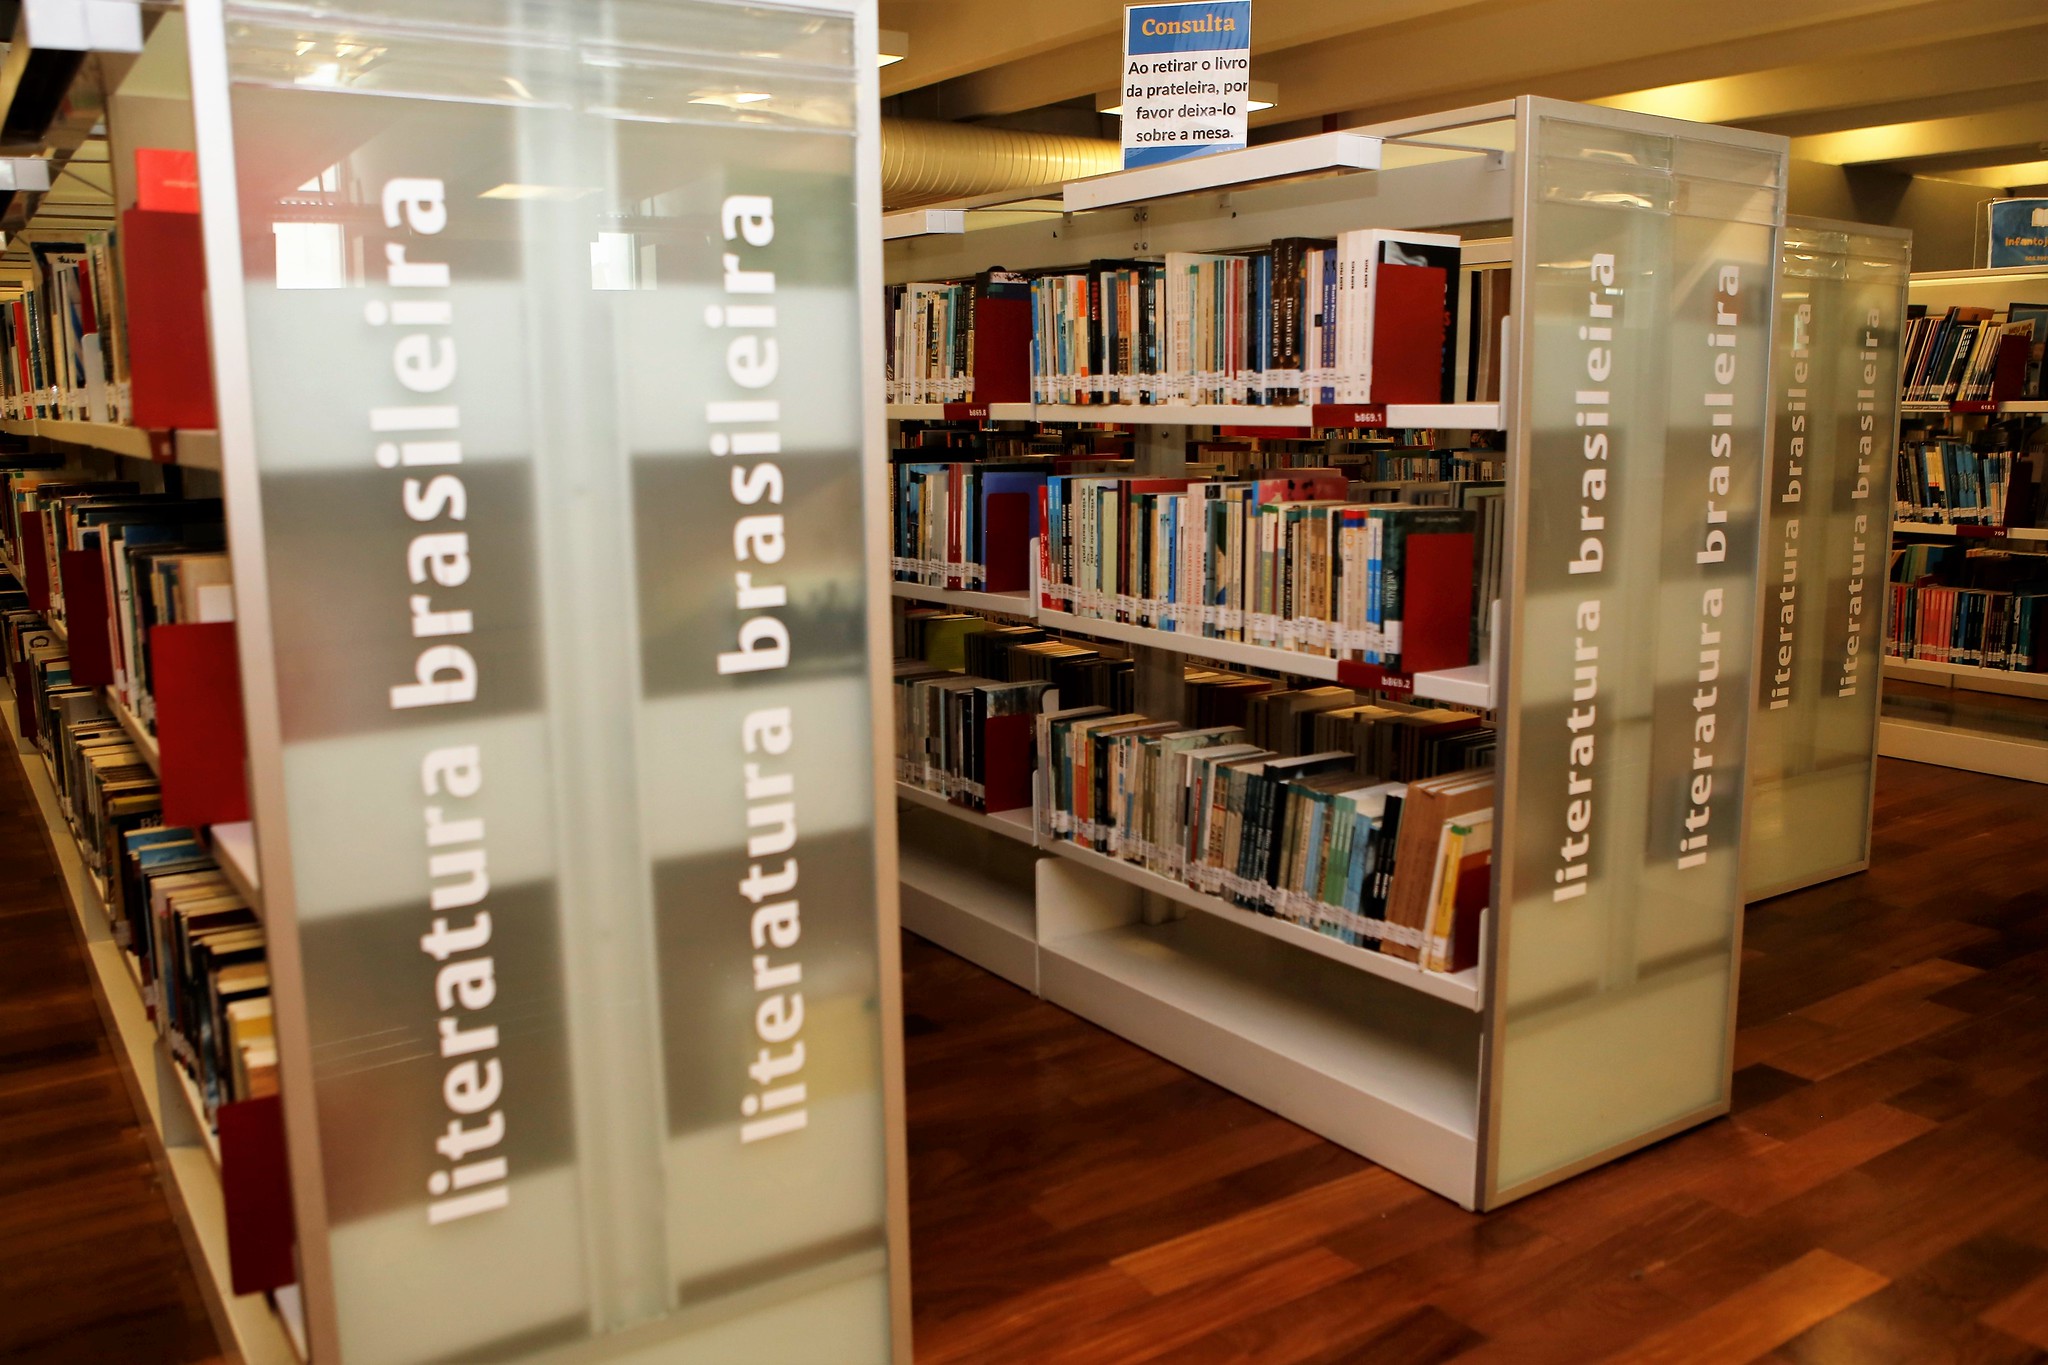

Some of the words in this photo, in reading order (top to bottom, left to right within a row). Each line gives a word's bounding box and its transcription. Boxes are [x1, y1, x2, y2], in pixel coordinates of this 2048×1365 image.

[1126, 84, 1143, 98] da
[1146, 80, 1220, 99] prateleira,
[1223, 82, 1248, 95] por
[1128, 61, 1149, 75] Ao
[1152, 58, 1198, 73] retirar
[1201, 60, 1211, 71] o
[1215, 56, 1248, 71] livro
[1136, 106, 1174, 119] favor
[1177, 102, 1236, 118] deixa-lo
[1141, 13, 1236, 37] Consulta
[1136, 129, 1176, 142] sobre
[1180, 130, 1188, 140] a
[1192, 128, 1234, 140] mesa.
[364, 176, 479, 711] brasileira
[704, 194, 791, 676] brasileira
[1568, 252, 1615, 575] brasileira
[1696, 264, 1740, 565] brasileira
[1781, 302, 1811, 503] brasileira
[1851, 307, 1880, 500] brasileira
[1769, 518, 1799, 711] literatura
[1838, 513, 1867, 698] literatura
[1553, 599, 1600, 903] literatura
[1677, 587, 1724, 871] literatura
[420, 744, 509, 1226] literatura
[739, 707, 808, 1144] literatura
